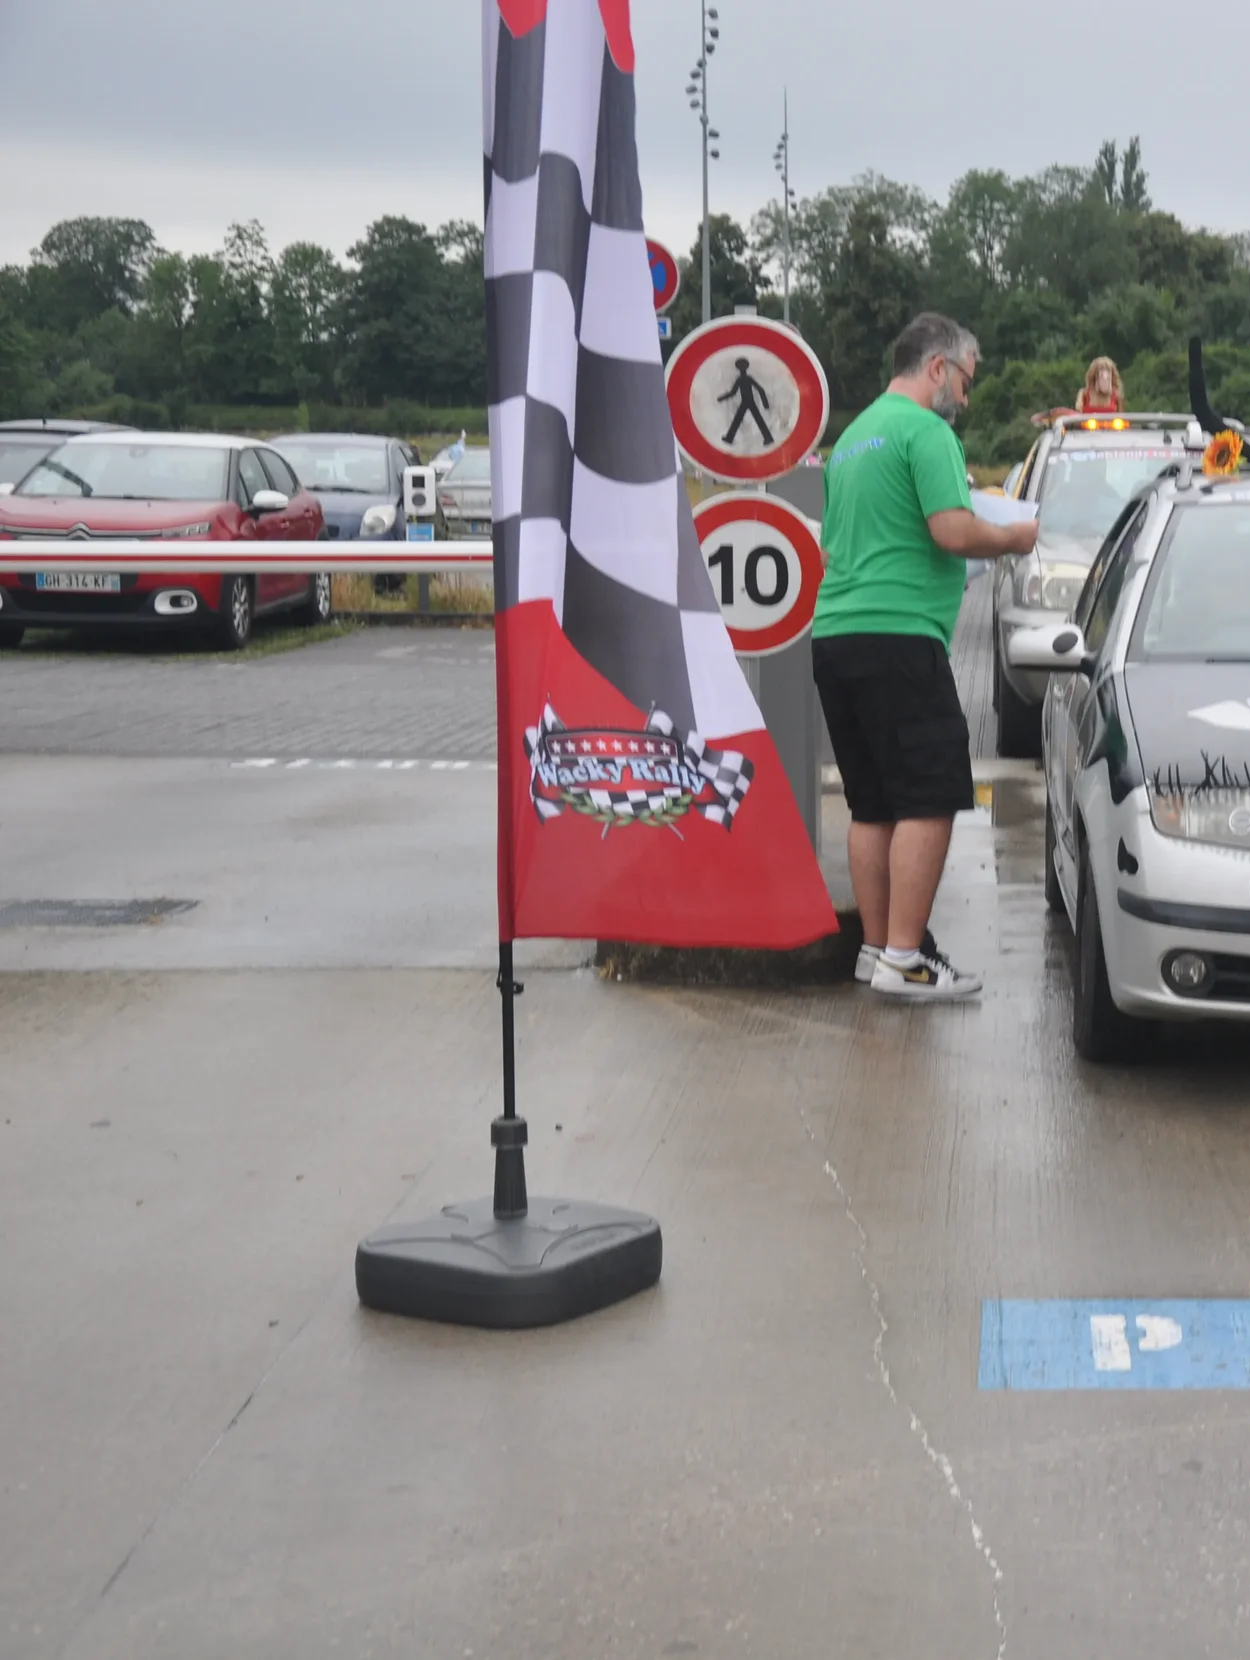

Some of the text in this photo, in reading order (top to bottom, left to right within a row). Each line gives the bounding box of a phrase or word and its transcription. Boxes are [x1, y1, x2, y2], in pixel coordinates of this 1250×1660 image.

[708, 545, 789, 606] 10
[537, 757, 706, 795] Wacky Rally
[1090, 1314, 1182, 1372] P
